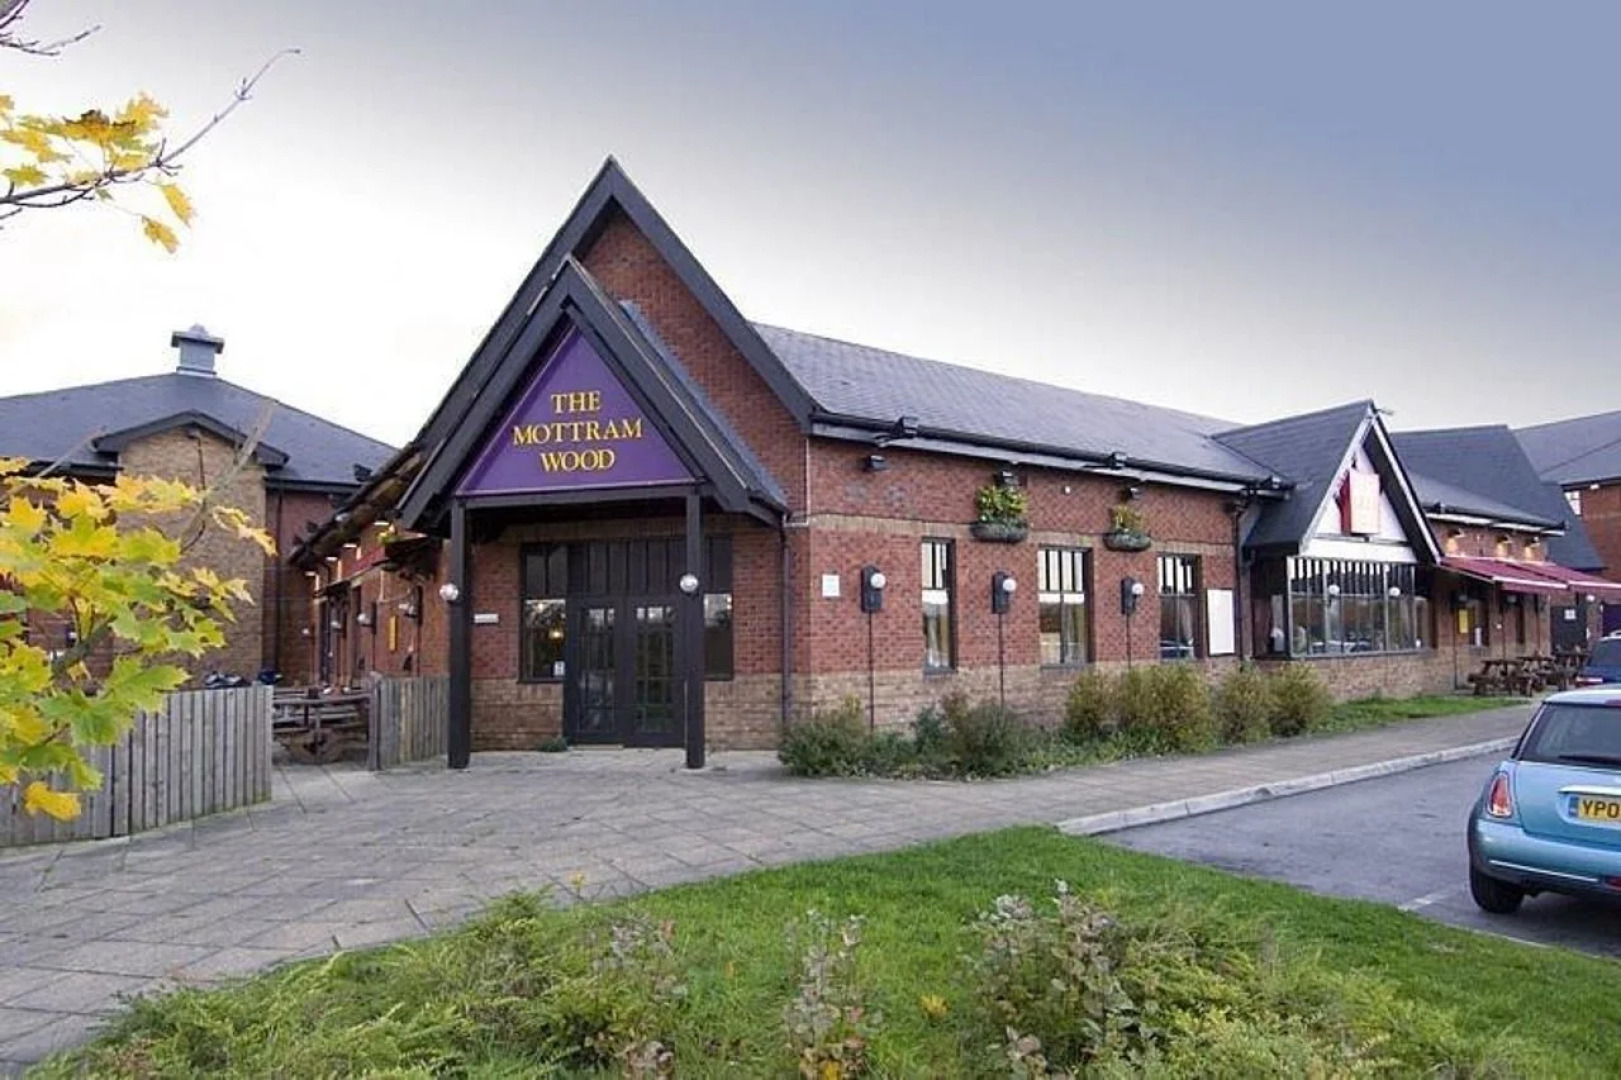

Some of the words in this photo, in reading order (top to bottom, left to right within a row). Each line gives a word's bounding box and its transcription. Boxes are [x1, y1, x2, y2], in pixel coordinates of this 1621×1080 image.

[551, 391, 601, 413] THE
[513, 418, 642, 446] MOTTRAM
[540, 449, 616, 472] WOOD
